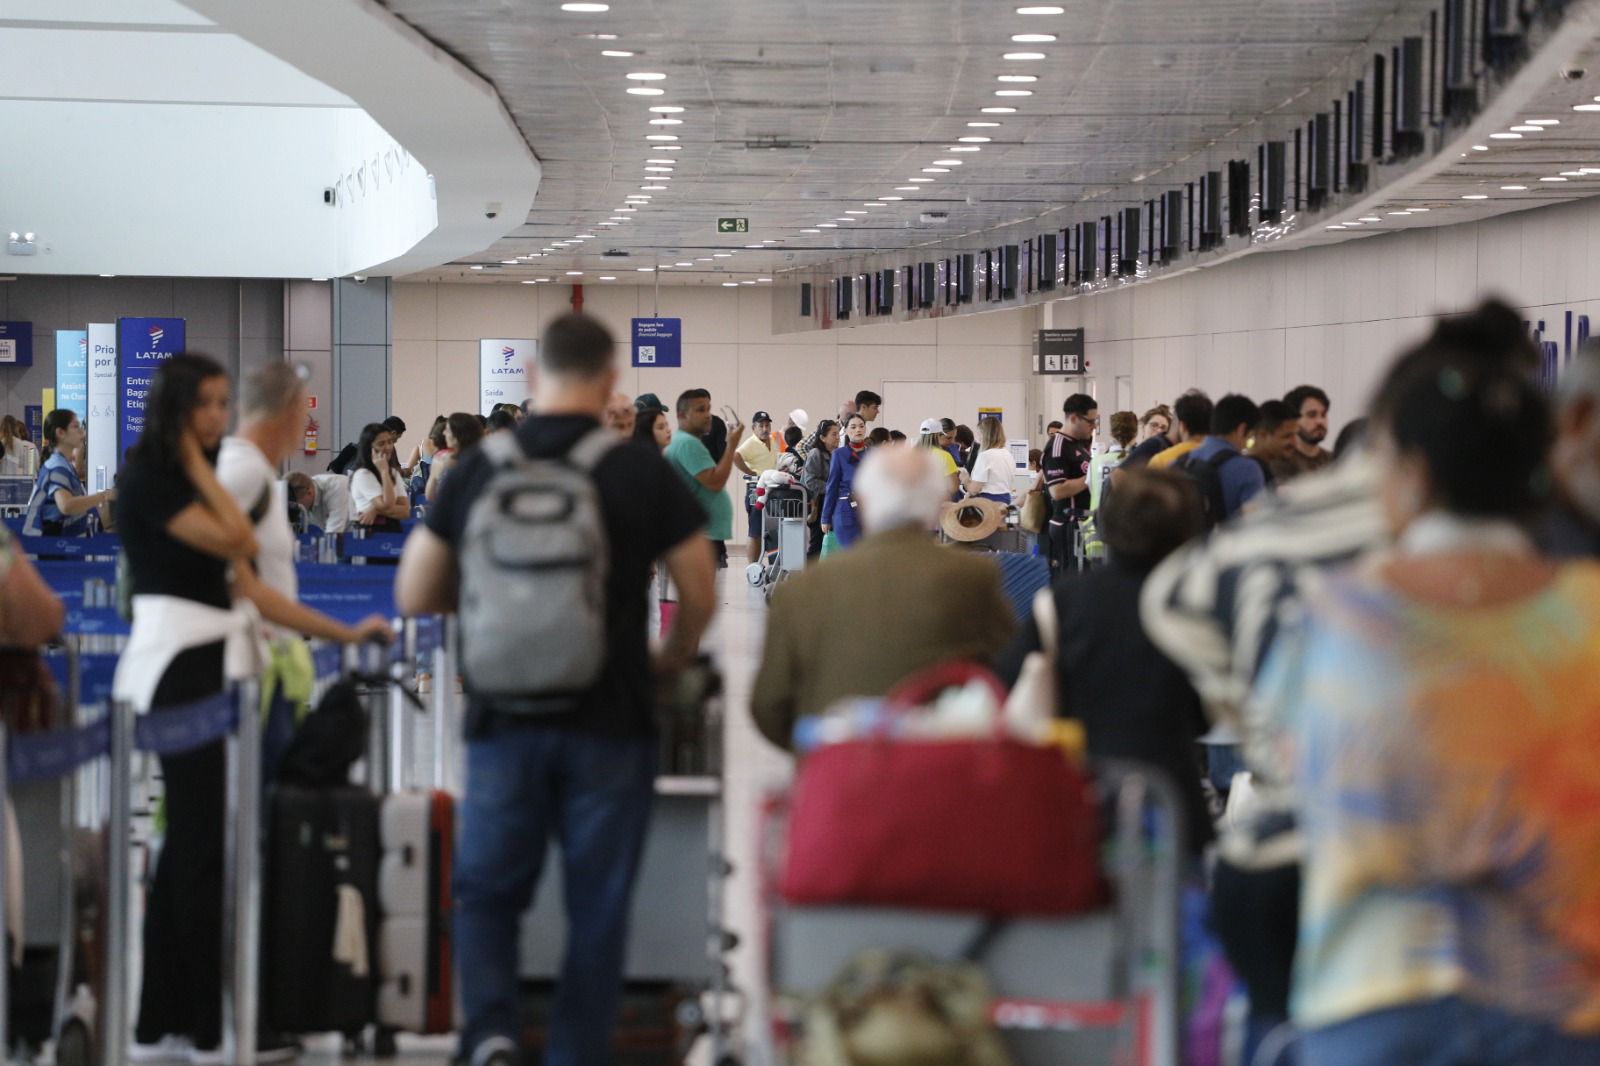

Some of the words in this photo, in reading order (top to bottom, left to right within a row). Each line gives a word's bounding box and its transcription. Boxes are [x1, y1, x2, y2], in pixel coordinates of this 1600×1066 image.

[136, 351, 173, 359] LATAM
[95, 359, 111, 368] por
[126, 377, 152, 385] Entre
[126, 388, 149, 398] Baga
[126, 424, 144, 432] Bagg
